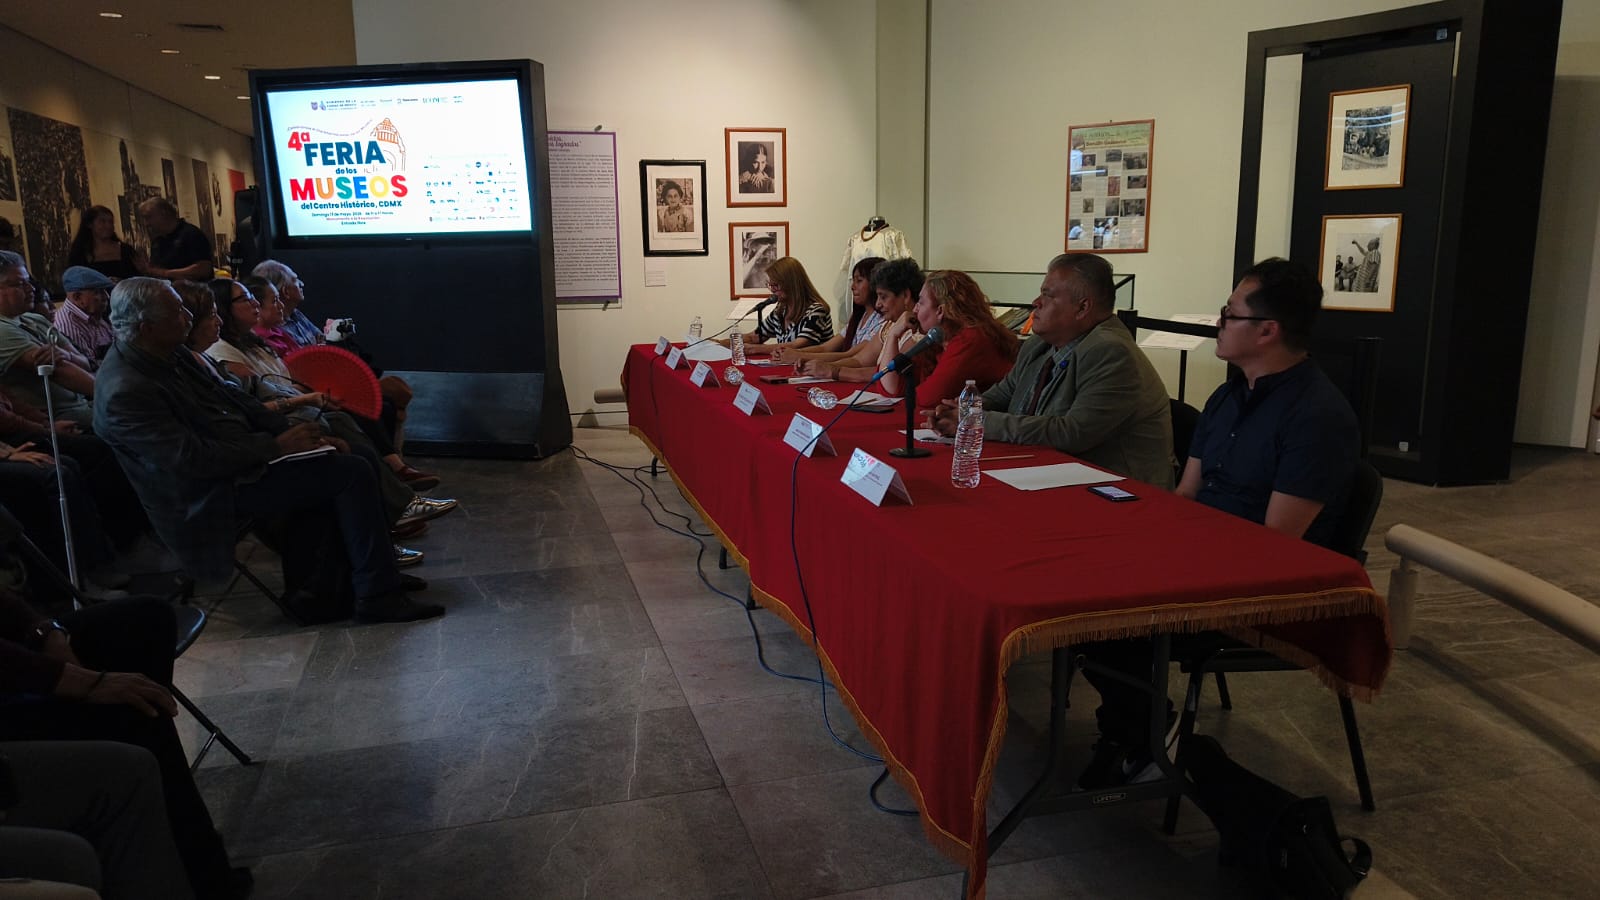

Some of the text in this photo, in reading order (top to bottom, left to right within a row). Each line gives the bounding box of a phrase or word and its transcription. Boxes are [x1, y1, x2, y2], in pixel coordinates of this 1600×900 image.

[304, 140, 387, 167] FERIA
[290, 174, 408, 201] MUSEOS
[301, 200, 402, 210] del Centro Histórico, CDMX
